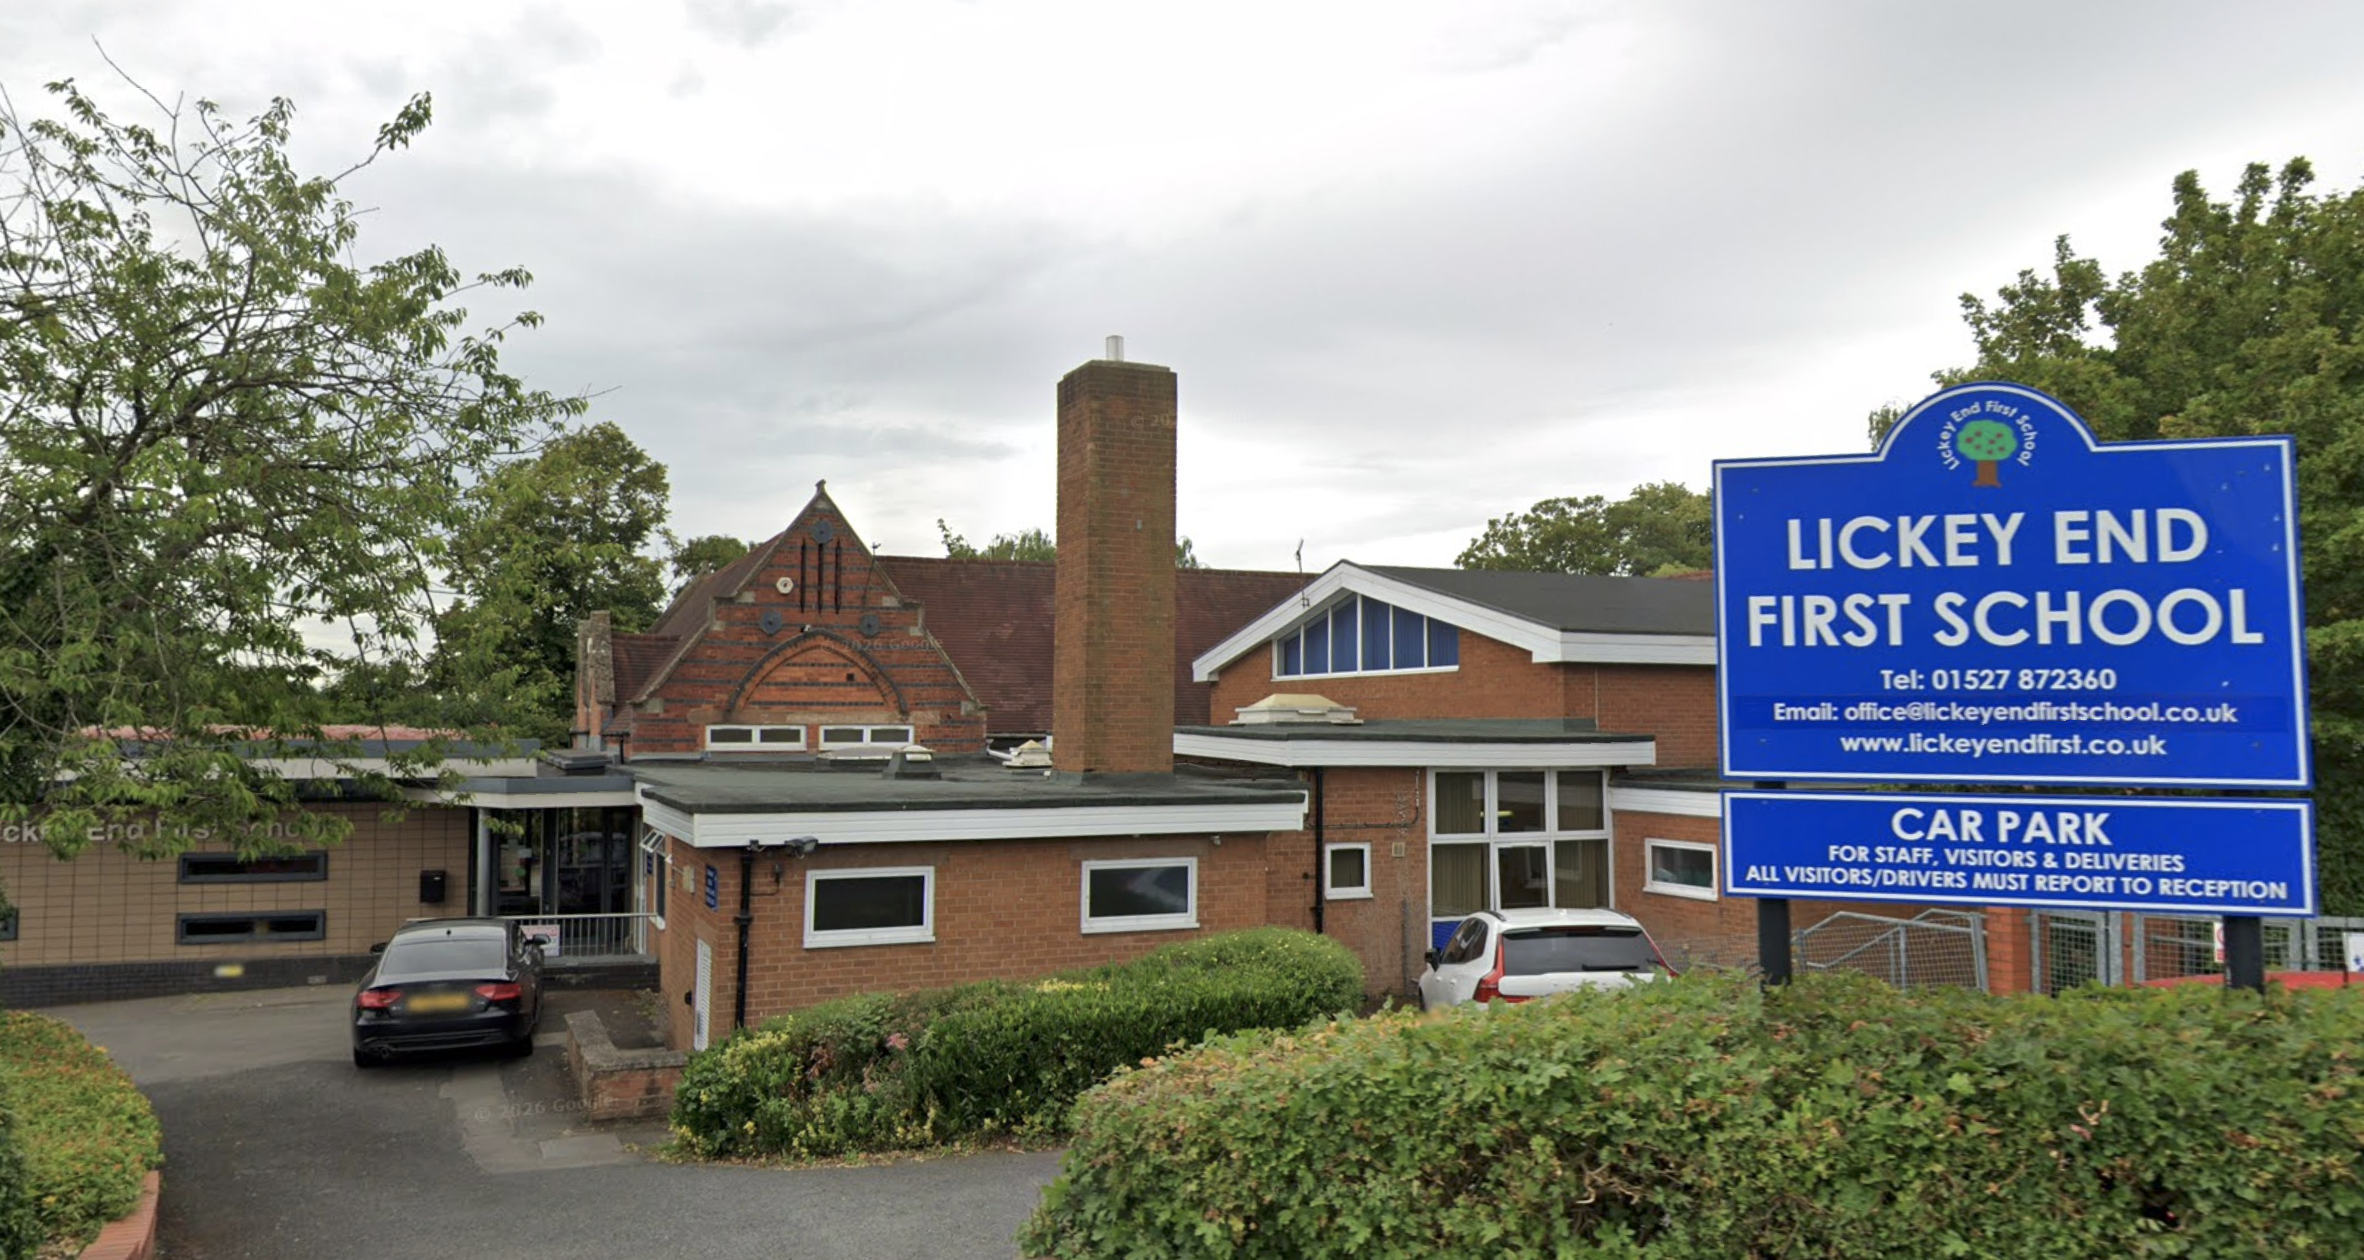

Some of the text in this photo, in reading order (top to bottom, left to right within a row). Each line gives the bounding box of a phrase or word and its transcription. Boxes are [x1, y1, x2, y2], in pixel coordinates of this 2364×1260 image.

[1936, 400, 2038, 470] Lickey End First School
[1788, 508, 2208, 570] LICKEY END
[1748, 588, 2264, 647] FIRST SCHOOL
[1880, 668, 2117, 690] Tel: 01527 872360
[1774, 702, 2238, 725] Email: office@lickeyendfirstschool.co.uk
[1840, 733, 2167, 758] www.lickeyendfirst.co.uk
[1892, 807, 2113, 845] CAR PARK
[1828, 845, 2185, 873] FOR STAFF, VISITORS & DELIVERIES
[1746, 865, 2287, 900] ALL VISITORS/DRIVERS MUST REPORT TO RECEPTION
